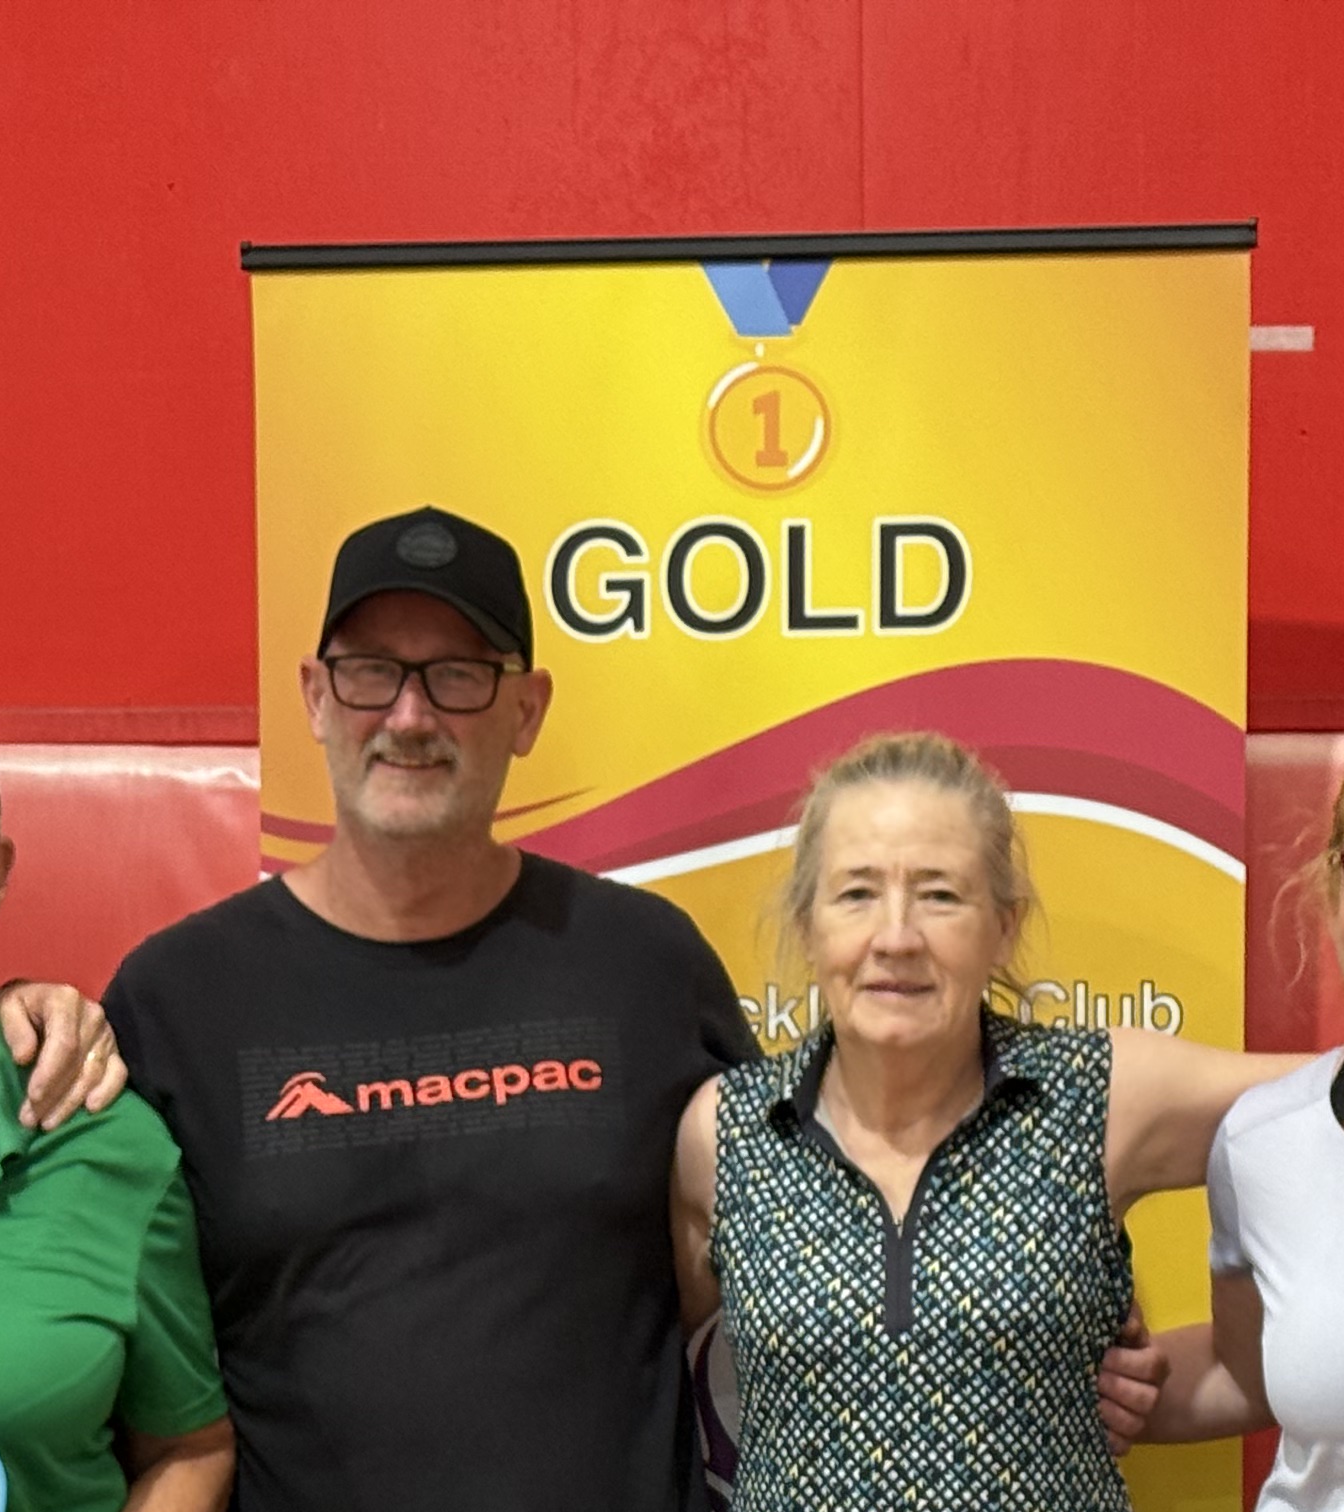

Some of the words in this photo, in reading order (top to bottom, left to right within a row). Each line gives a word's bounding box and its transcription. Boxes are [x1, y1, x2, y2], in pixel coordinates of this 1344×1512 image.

[752, 389, 789, 468] 1
[548, 519, 969, 637] GOLD
[356, 1057, 603, 1113] macpac
